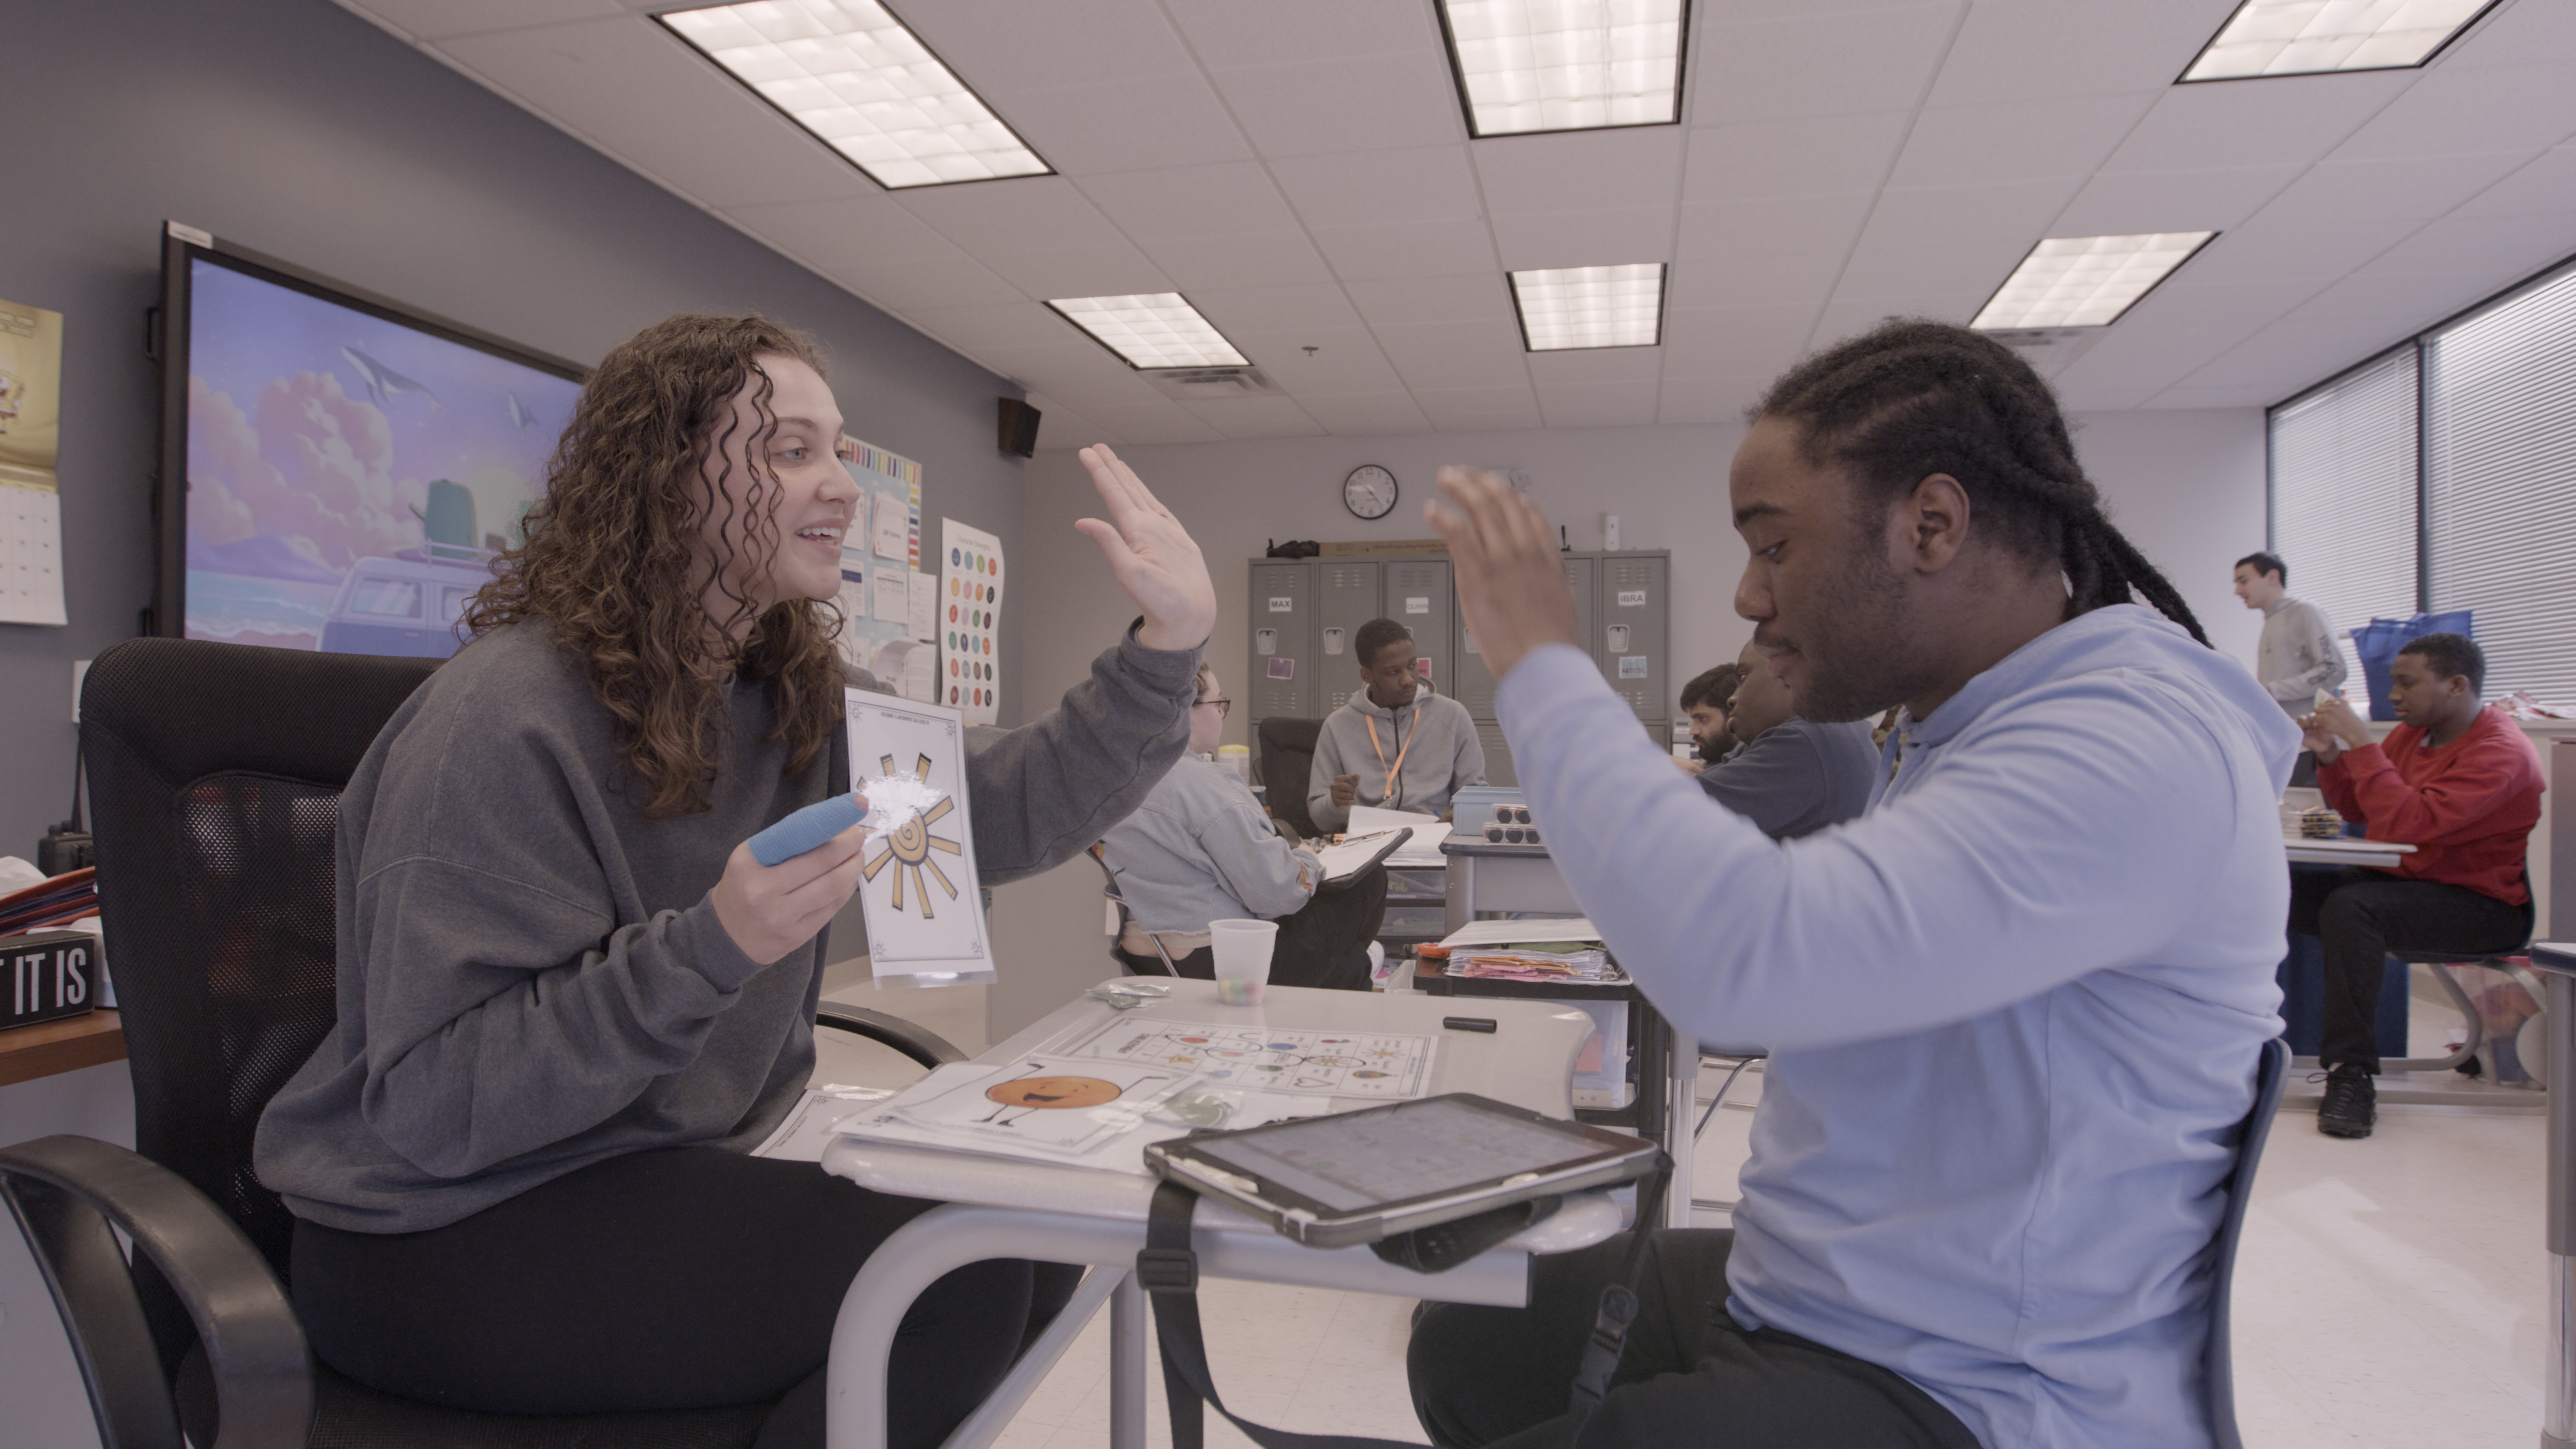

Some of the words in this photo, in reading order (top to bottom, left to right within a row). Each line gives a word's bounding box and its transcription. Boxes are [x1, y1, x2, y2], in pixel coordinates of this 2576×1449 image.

[1620, 594, 1643, 602] IBRA
[15, 953, 46, 1015] IT
[56, 948, 86, 1007] IS
